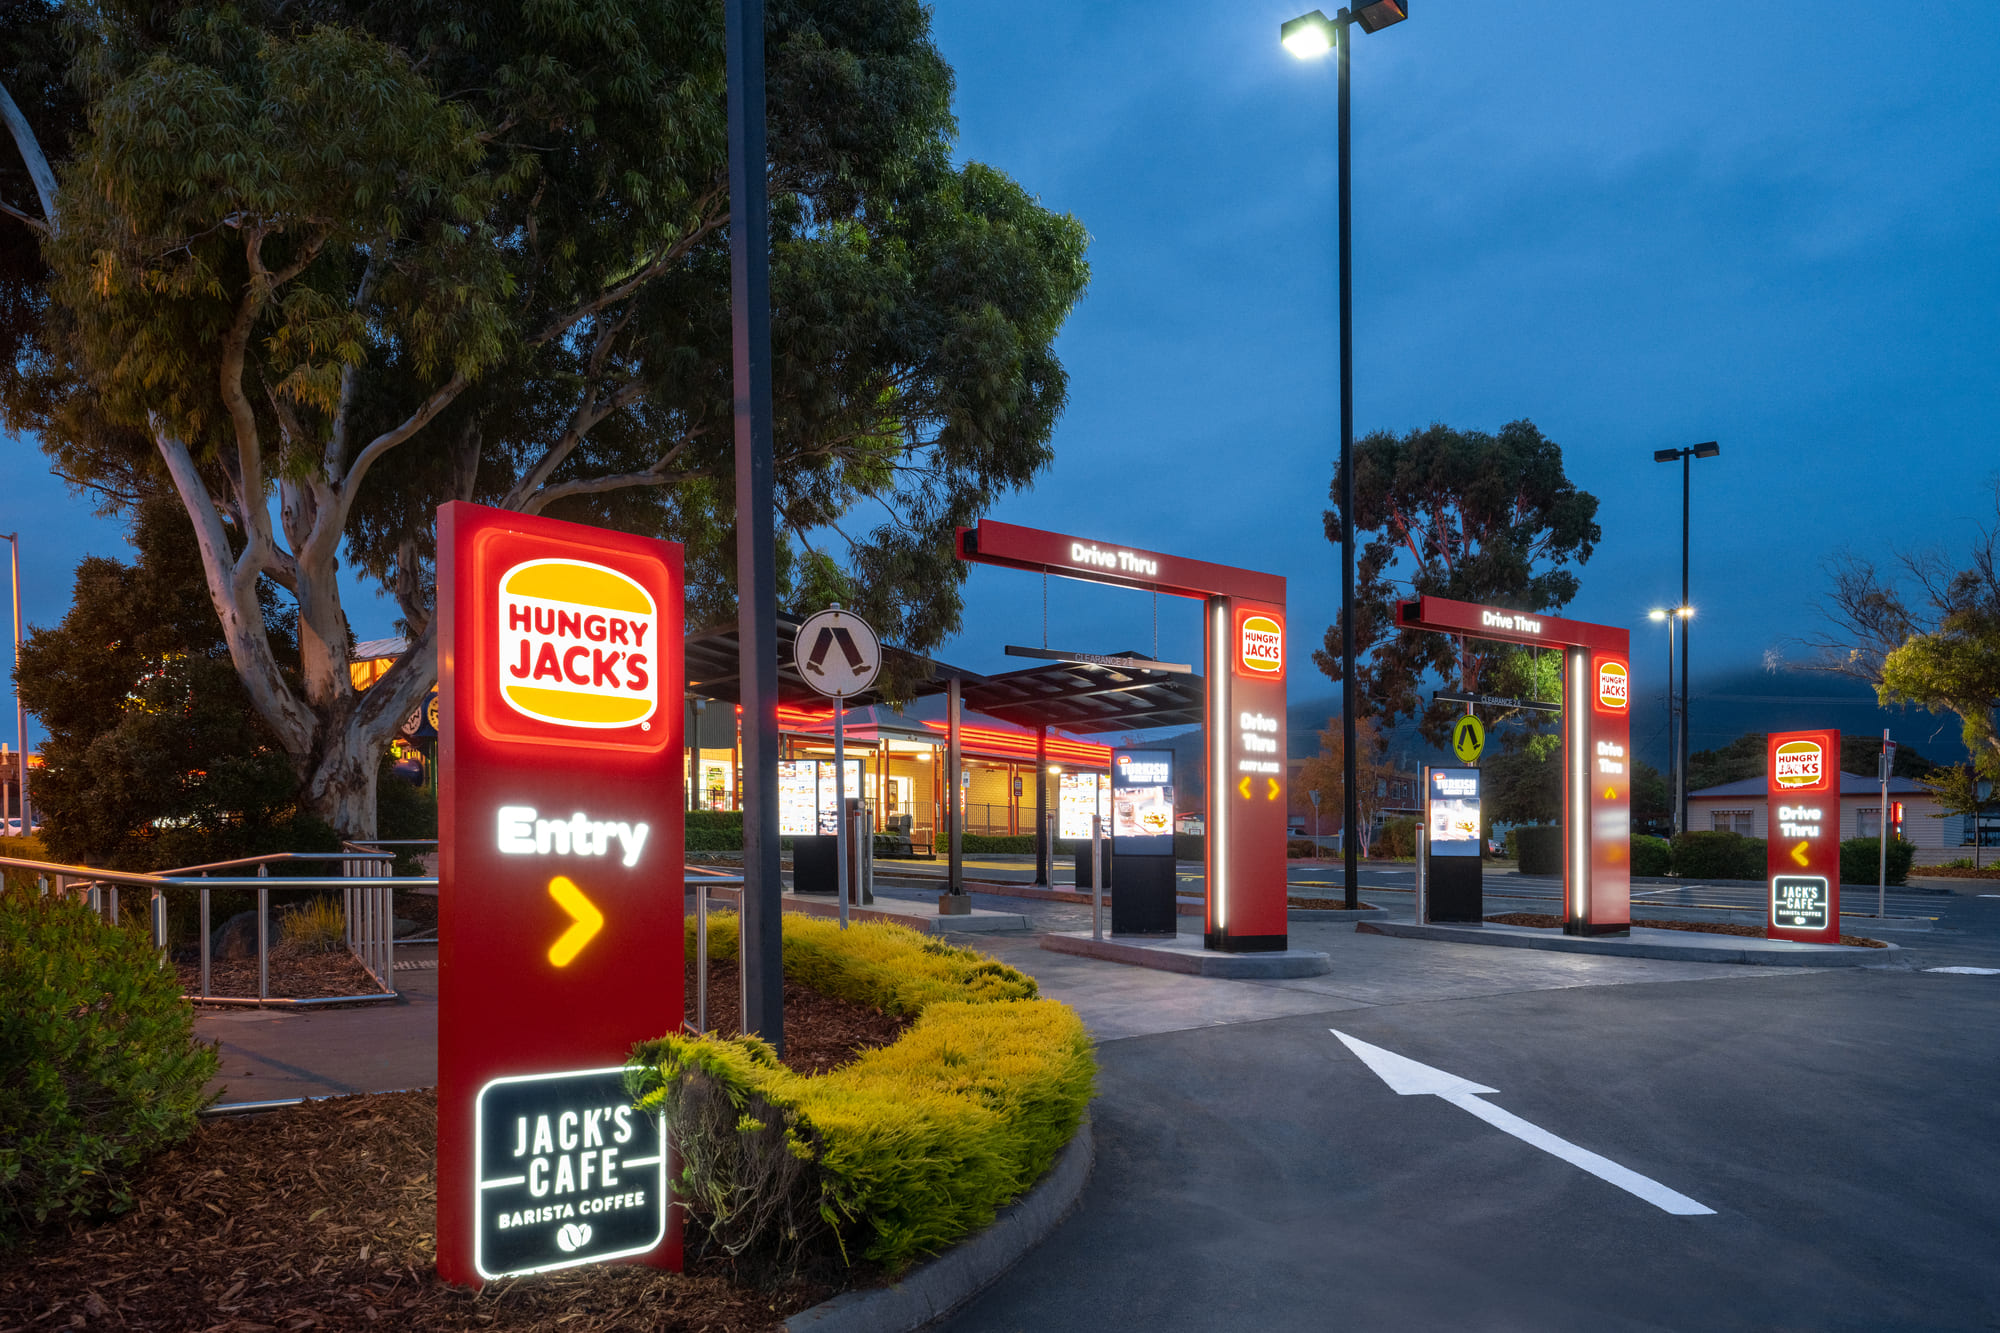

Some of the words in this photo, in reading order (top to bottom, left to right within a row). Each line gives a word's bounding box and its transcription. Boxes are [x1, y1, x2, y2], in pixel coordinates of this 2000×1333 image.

[1072, 543, 1117, 568] Drive
[1118, 551, 1157, 575] Thru
[509, 603, 648, 647] HUNGRY
[1482, 611, 1513, 629] Drive
[1513, 615, 1541, 633] Thru
[1245, 631, 1279, 645] HUNGRY
[509, 639, 649, 691] JACK'S
[1075, 653, 1121, 666] CLEARANCE
[1601, 675, 1625, 685] HUNGRY
[1481, 696, 1512, 706] CLEARANCE
[1240, 712, 1277, 732] Drive
[1242, 733, 1276, 752] Thru
[1597, 741, 1623, 757] Drive
[1598, 758, 1623, 774] Thru
[1779, 754, 1819, 763] HUNGRY
[1120, 763, 1168, 776] TURKISH
[1436, 779, 1476, 790] TURKISH
[1779, 805, 1822, 820] Drive
[499, 806, 649, 867] Entry
[1780, 822, 1819, 837] Thru
[1782, 886, 1818, 899] JACK'S
[1787, 897, 1814, 910] CAFE
[514, 1105, 632, 1157] JACK'S
[529, 1148, 618, 1197] CAFE
[498, 1203, 575, 1229] BARISTA
[579, 1191, 645, 1215] COFFEE
